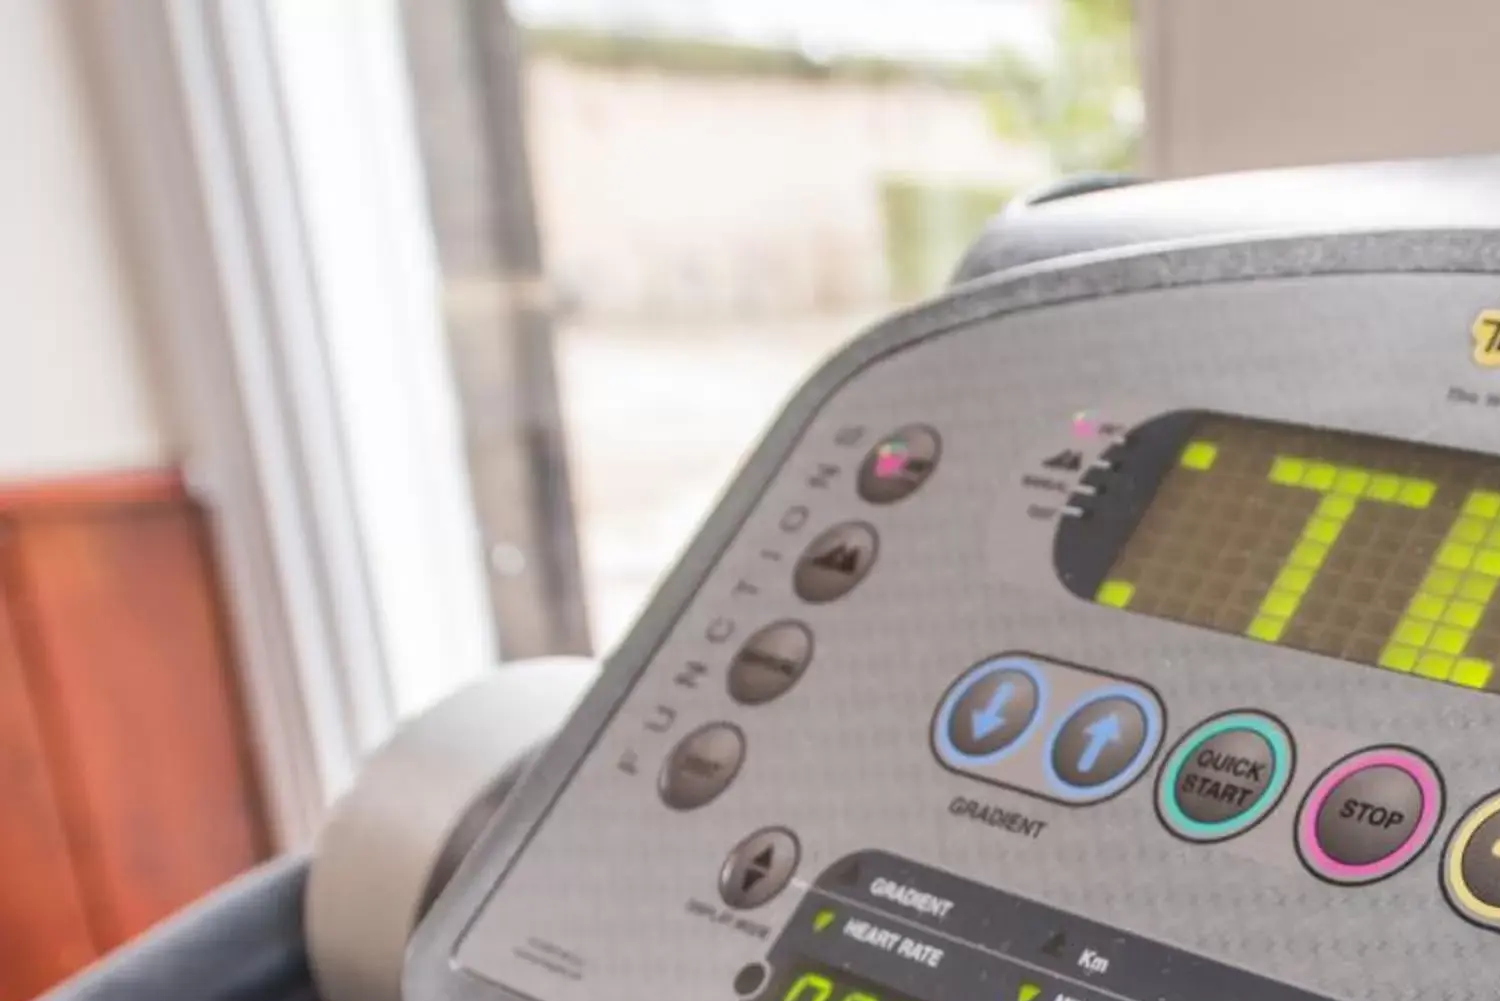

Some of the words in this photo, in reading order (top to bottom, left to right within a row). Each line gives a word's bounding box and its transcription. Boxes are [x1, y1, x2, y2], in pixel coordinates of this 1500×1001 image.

[1196, 749, 1265, 782] QUICK
[1181, 774, 1253, 807] START
[948, 796, 1047, 840] GRADIENT
[1339, 800, 1404, 830] STOP
[870, 877, 954, 917] GRADIENT
[843, 918, 900, 953] HEART
[897, 936, 944, 968] RATE
[1077, 948, 1109, 973] Km
